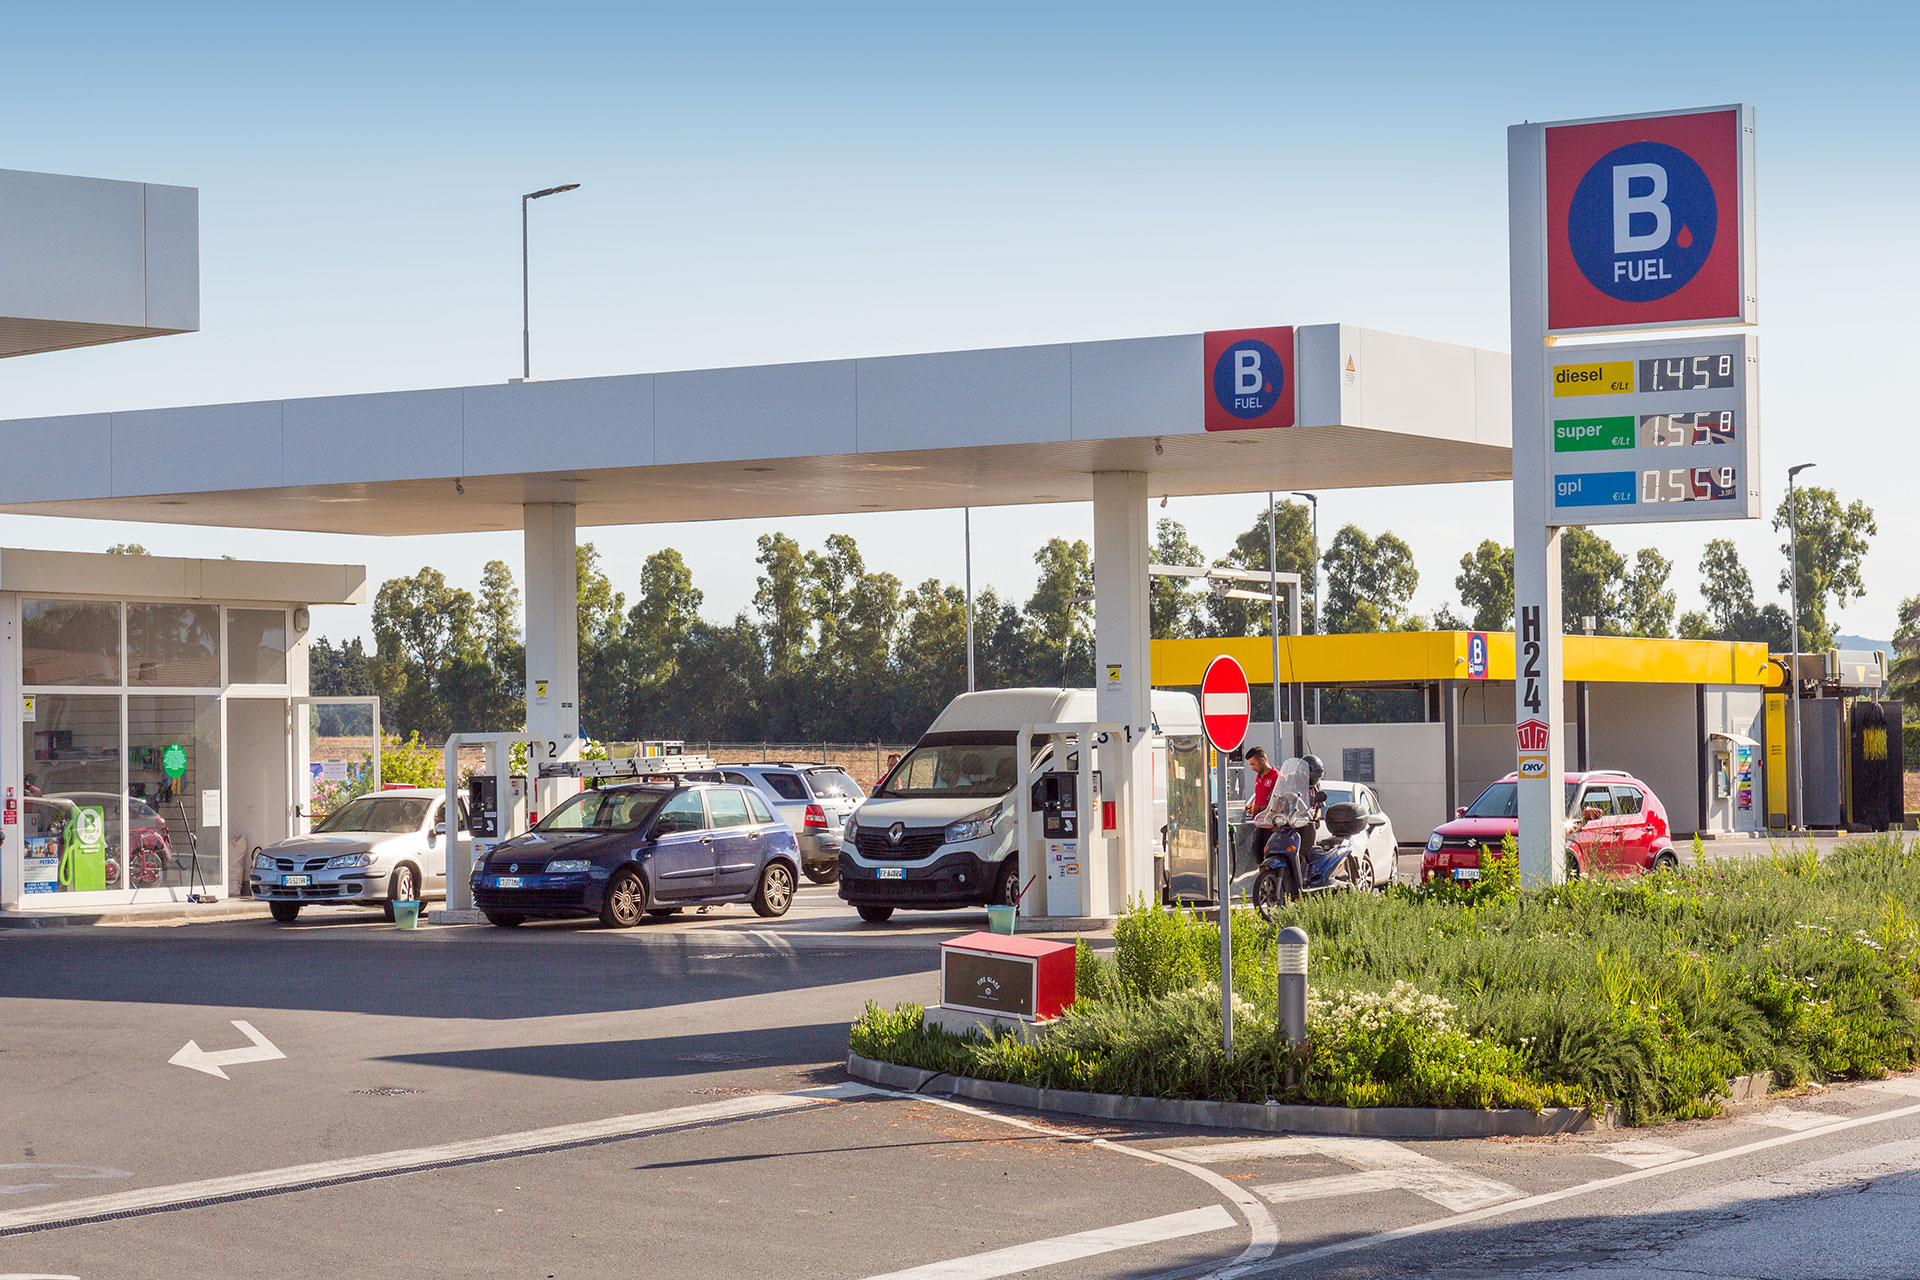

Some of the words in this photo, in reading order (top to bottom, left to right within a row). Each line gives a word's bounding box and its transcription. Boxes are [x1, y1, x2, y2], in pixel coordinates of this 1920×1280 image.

[1613, 163, 1671, 254] B
[1614, 259, 1672, 283] FUEL
[1234, 349, 1263, 395] B
[1556, 367, 1603, 383] diesel
[1611, 382, 1629, 391] €/Lt
[1234, 397, 1263, 409] FUEL
[1557, 424, 1603, 440] super
[1612, 437, 1630, 446] €/Lt
[1557, 478, 1582, 496] gpl
[1612, 492, 1631, 501] €/Lt
[1473, 639, 1483, 664] B
[1522, 606, 1541, 714] H24
[1517, 720, 1549, 749] UTA
[548, 741, 557, 758] 2
[1523, 763, 1544, 771] DKV
